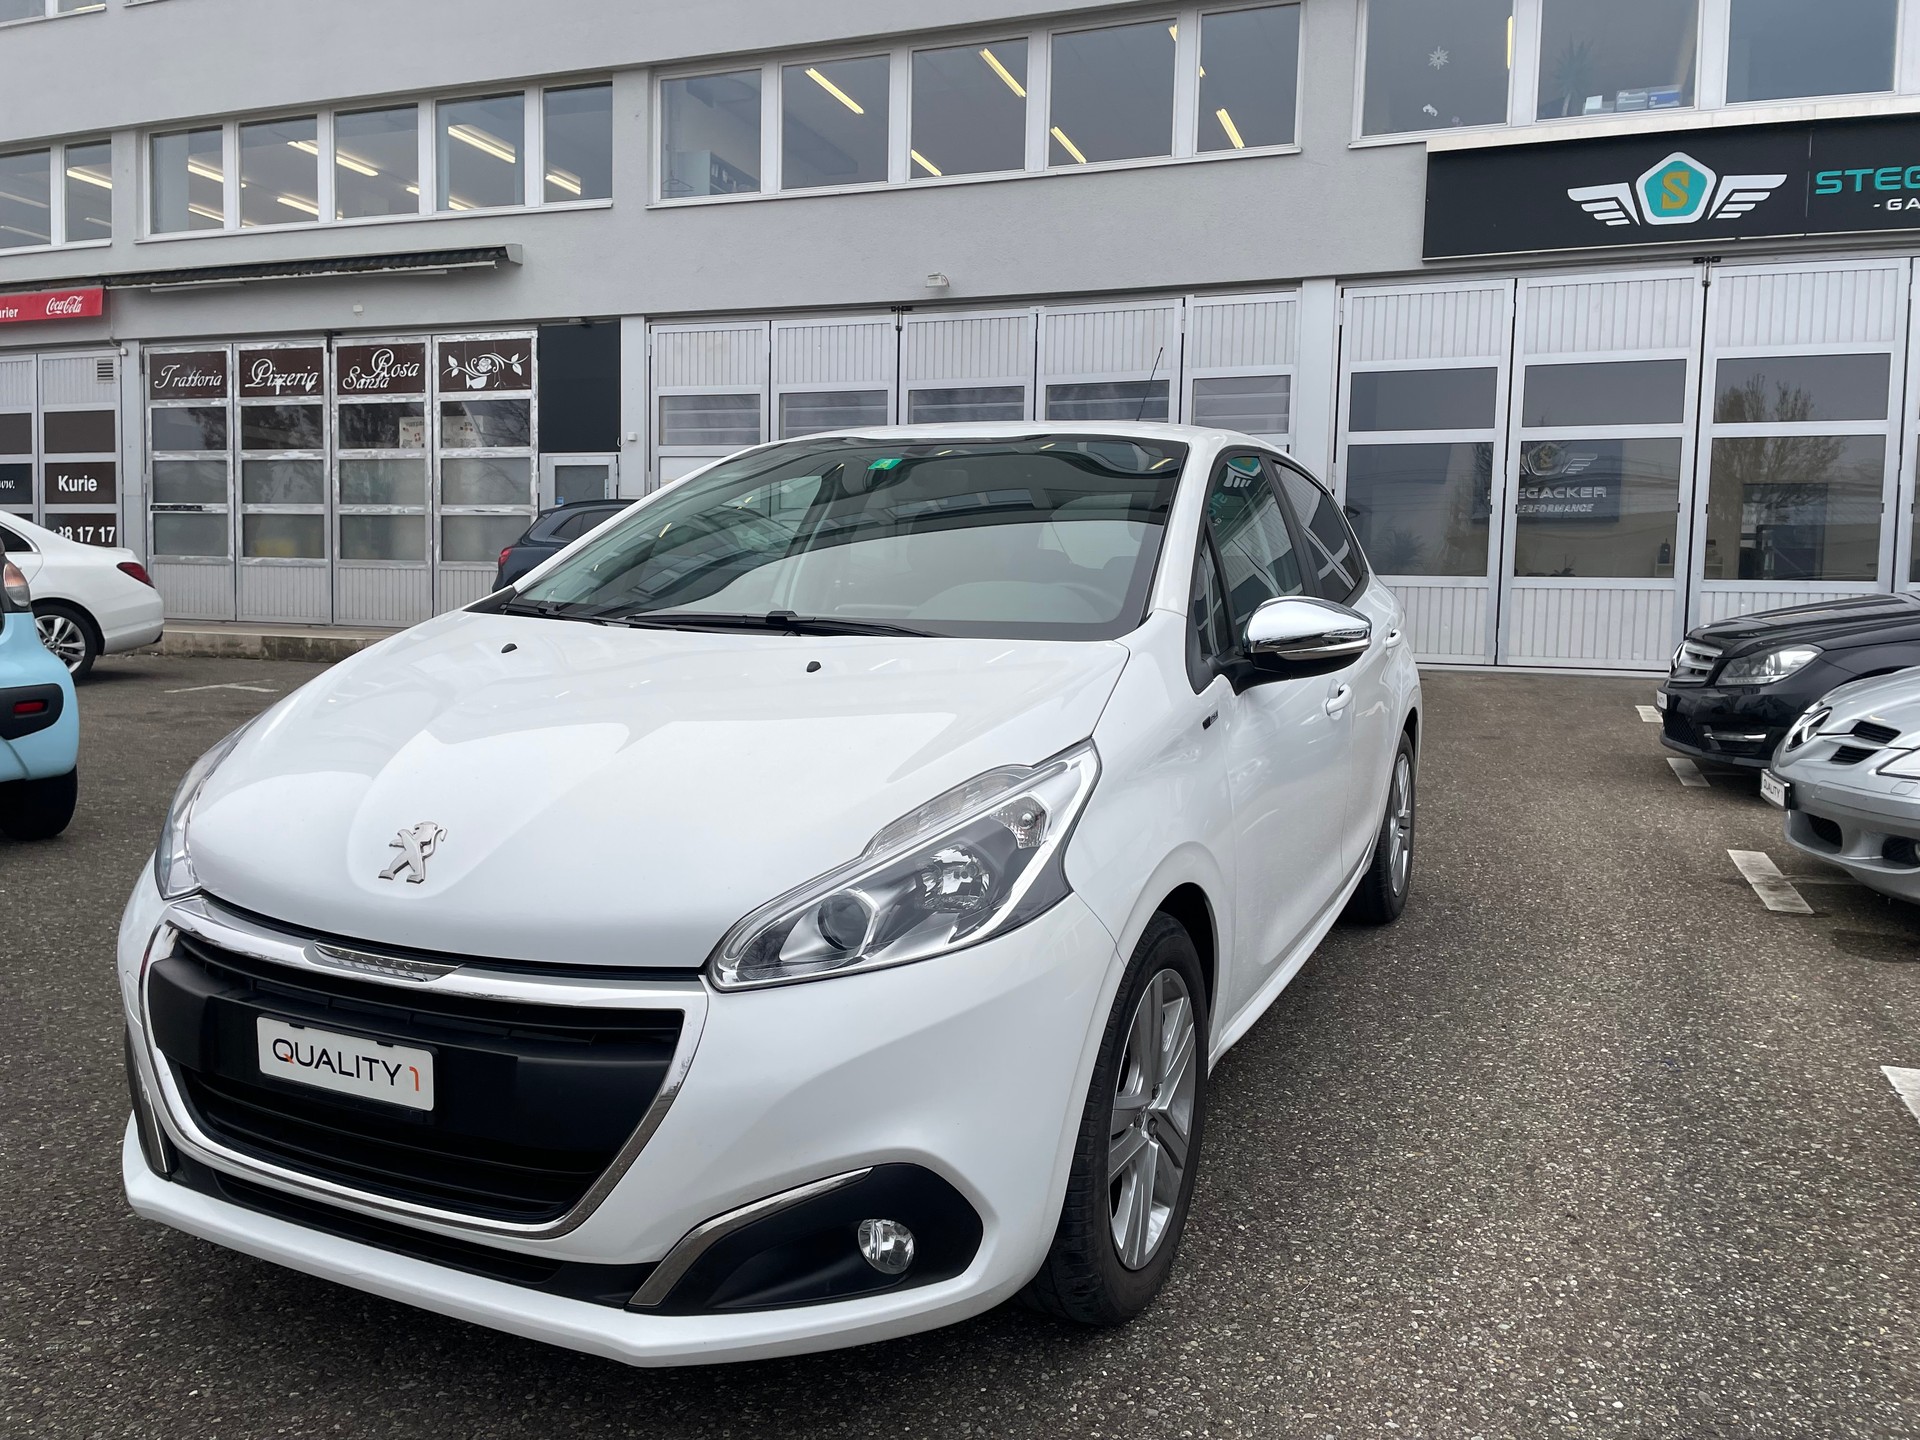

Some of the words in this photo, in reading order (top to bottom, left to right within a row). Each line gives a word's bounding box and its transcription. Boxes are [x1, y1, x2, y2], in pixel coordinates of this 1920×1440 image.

[1661, 171, 1690, 210] S
[1815, 165, 1920, 195] STEG
[154, 364, 223, 389] Trattoria
[245, 358, 319, 391] Pizzeria
[342, 366, 389, 390] Santa
[361, 348, 420, 380] Rosa
[58, 474, 98, 492] Kurie
[77, 526, 94, 543] 17
[98, 526, 115, 543] 17
[272, 1038, 403, 1086] QUALITY
[409, 1065, 420, 1092] 1
